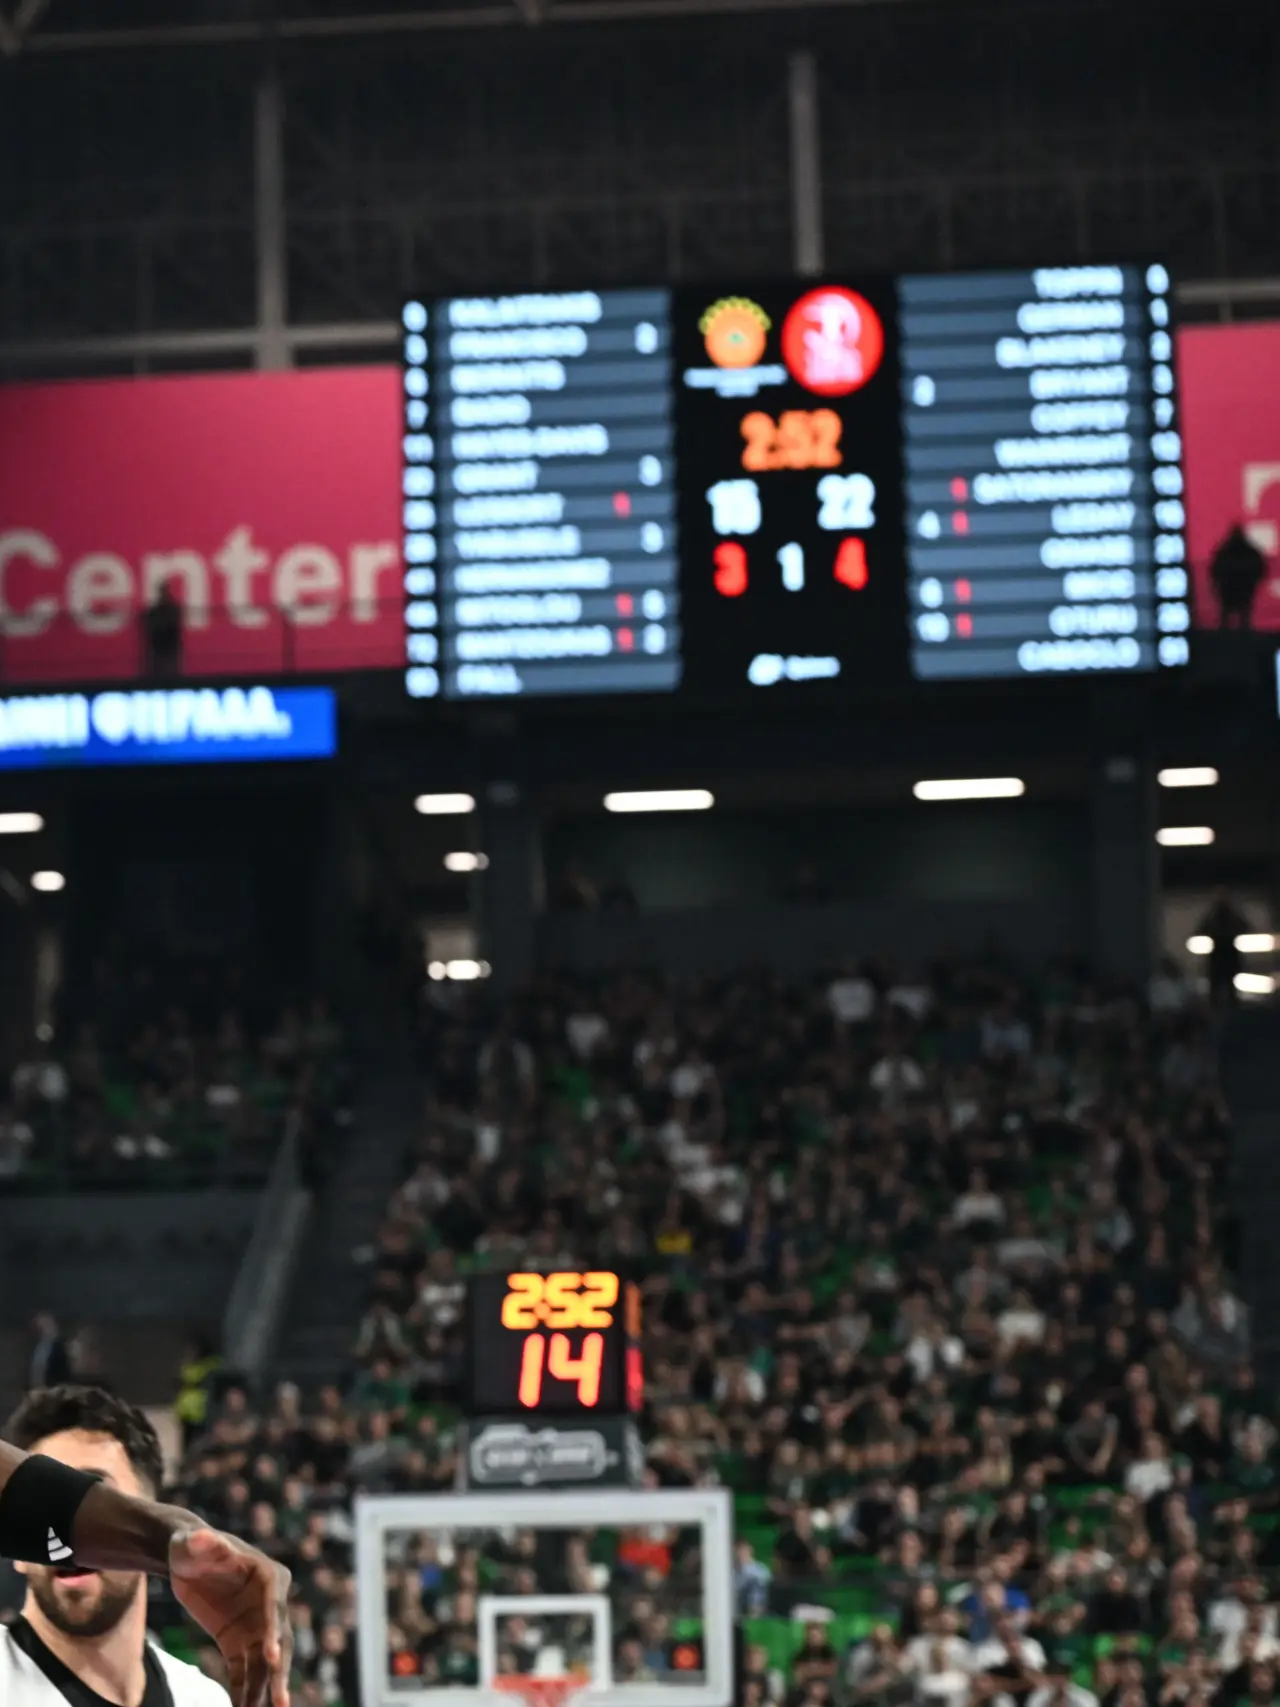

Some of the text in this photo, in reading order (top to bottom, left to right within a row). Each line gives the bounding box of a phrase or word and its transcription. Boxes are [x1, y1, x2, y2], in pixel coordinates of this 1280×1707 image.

[817, 473, 876, 530] 22
[713, 540, 749, 597] 3
[776, 541, 805, 592] 1
[501, 1271, 619, 1330] 2:52
[519, 1332, 604, 1408] 14
